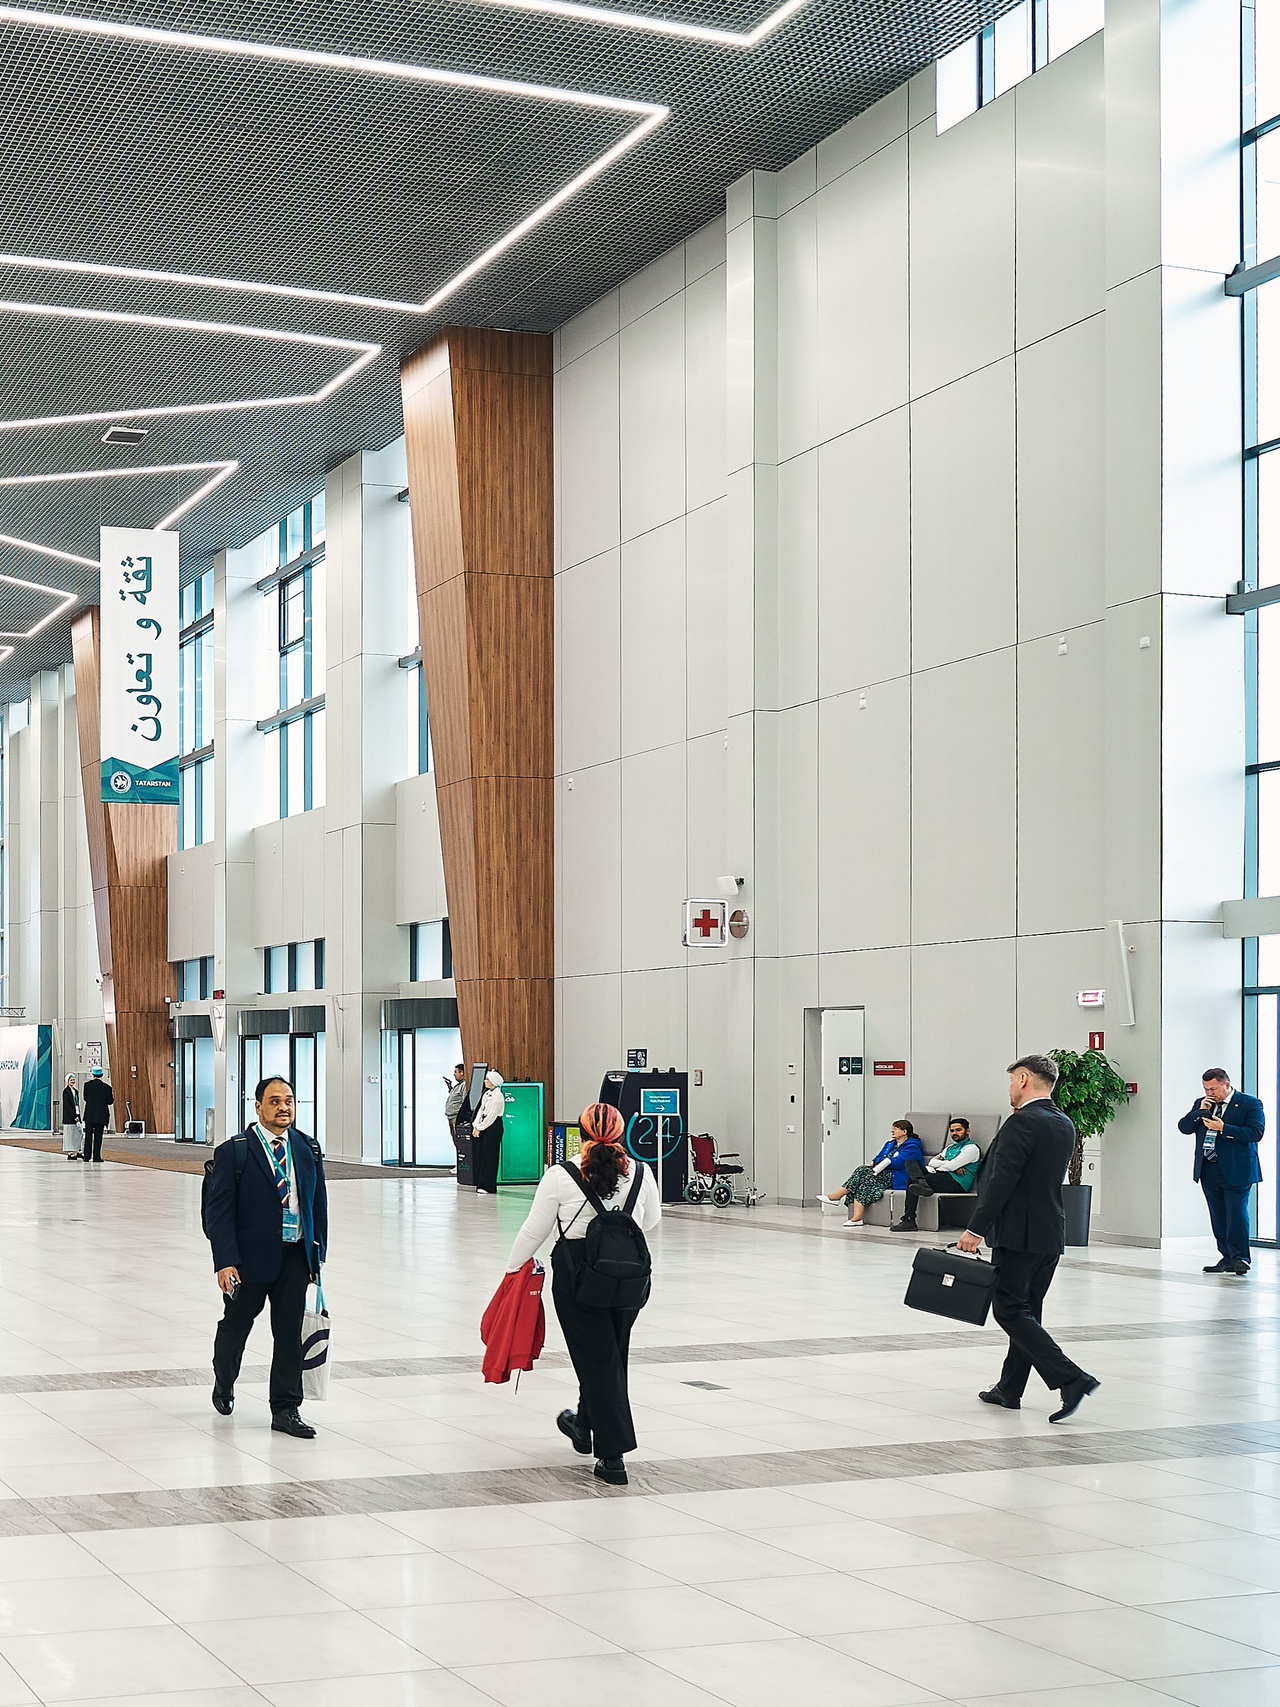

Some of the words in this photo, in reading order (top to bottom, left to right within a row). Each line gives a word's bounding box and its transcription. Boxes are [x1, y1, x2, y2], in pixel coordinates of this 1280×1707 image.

[119, 556, 153, 605] ثقة
[136, 617, 162, 641] و
[125, 653, 162, 742] تعاون
[134, 779, 171, 788] TATARSTAN
